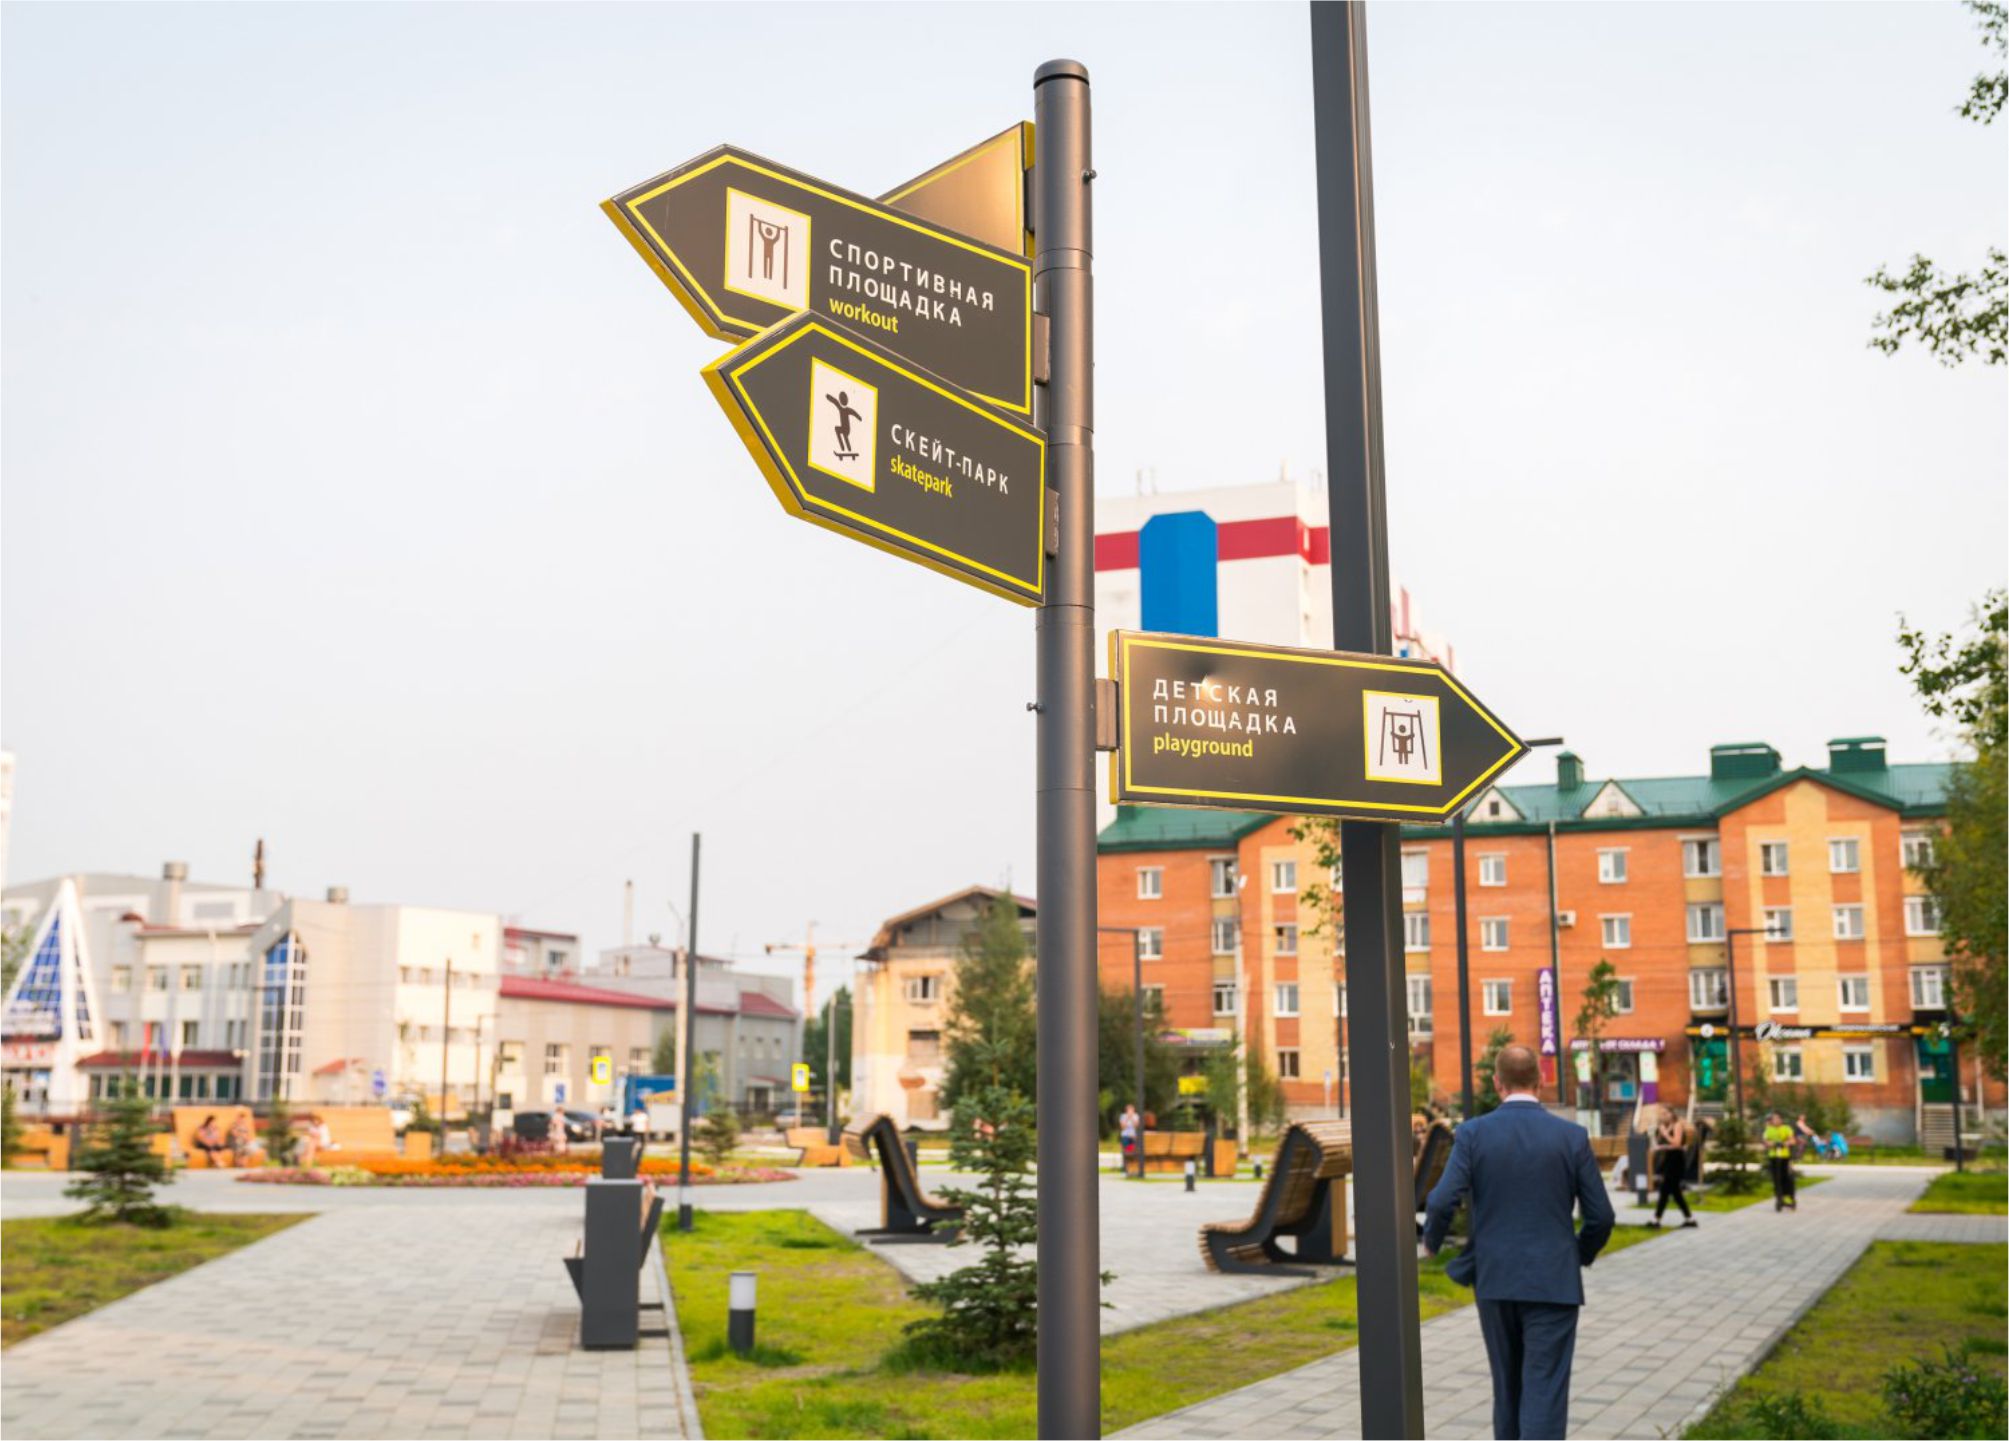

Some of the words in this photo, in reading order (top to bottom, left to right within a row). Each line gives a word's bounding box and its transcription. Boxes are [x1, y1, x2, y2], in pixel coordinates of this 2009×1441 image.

[829, 238, 994, 312] СПОРТИВНАЯ
[829, 264, 962, 328] ПЛОЩАДКА
[829, 297, 899, 334] workout
[890, 423, 1009, 495] СКЕЙТ-ПАРК
[890, 454, 953, 498] skatepark
[1153, 678, 1278, 707] ДЕТСКАЯ
[1154, 705, 1297, 735] ПЛОЩАДКА
[1153, 732, 1254, 759] playground
[1538, 969, 1556, 1053] АПТЕКА
